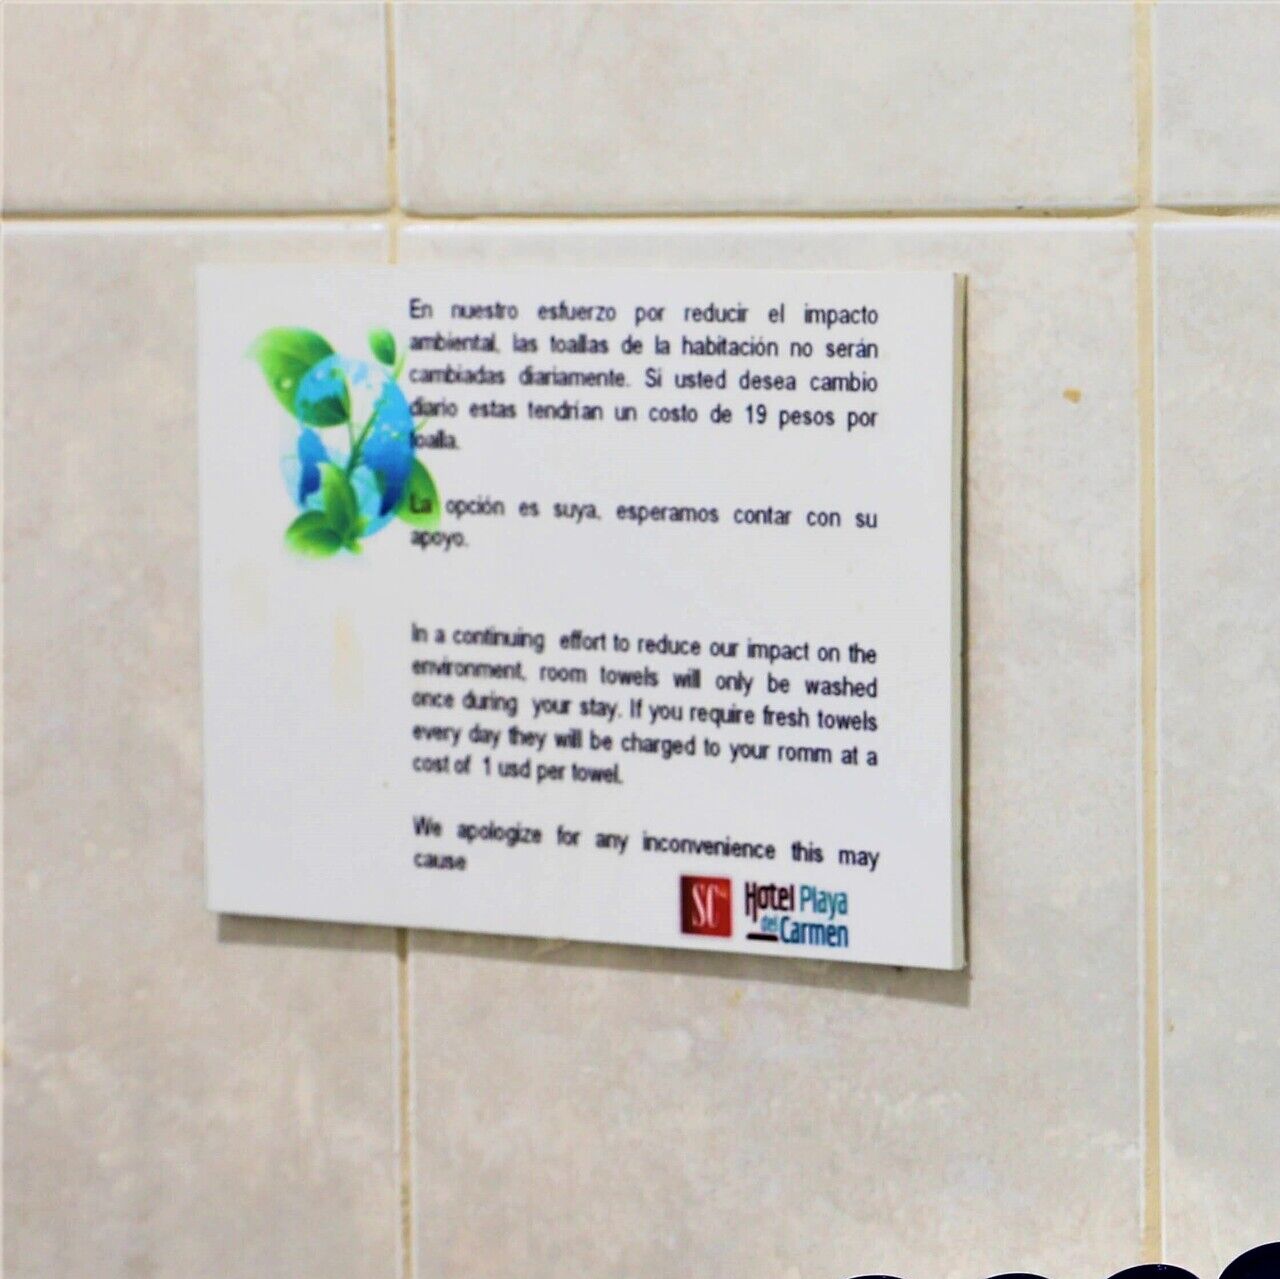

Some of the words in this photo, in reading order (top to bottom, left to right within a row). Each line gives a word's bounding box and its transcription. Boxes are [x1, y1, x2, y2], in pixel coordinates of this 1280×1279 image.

[409, 298, 433, 319] En
[451, 302, 518, 319] nuestro
[538, 301, 616, 321] esfuerzo
[635, 307, 664, 326] por
[685, 303, 748, 323] reducir
[768, 303, 784, 323] el
[804, 306, 878, 329] impacto
[513, 334, 538, 353] las
[550, 334, 609, 354] toallas
[621, 335, 643, 355] de
[655, 335, 670, 355] la
[682, 336, 778, 356] habitación
[790, 342, 813, 357] no
[826, 339, 878, 358] serán
[409, 364, 505, 385] cambiadas
[519, 365, 631, 387] diariamente.
[645, 367, 662, 388] Si
[675, 369, 727, 389] usted
[739, 370, 796, 391] desea
[810, 371, 878, 392] cambio
[410, 397, 458, 417] diario
[469, 400, 517, 418] estas
[615, 406, 637, 421] un
[649, 404, 698, 423] costo
[710, 404, 732, 424] de
[746, 404, 767, 424] 19
[779, 410, 835, 430] pesos
[847, 411, 878, 432] por
[410, 493, 432, 514] La
[446, 499, 505, 519] opción
[519, 502, 540, 517] es
[616, 505, 719, 525] esperamos
[734, 506, 792, 525] contar
[807, 511, 841, 527] con
[855, 513, 877, 528] su
[411, 530, 468, 551] apoyo.
[412, 623, 428, 642] In
[435, 629, 446, 644] a
[453, 627, 545, 654] continuing
[559, 630, 606, 651] effort
[613, 634, 630, 652] to
[638, 634, 701, 656] reduce
[709, 642, 739, 657] our
[747, 639, 809, 664] impact
[817, 647, 840, 662] on
[848, 643, 877, 664] the
[540, 666, 587, 683] room
[600, 666, 659, 687] towels
[673, 668, 701, 689] will
[715, 671, 754, 697] only
[767, 672, 790, 694] be
[805, 676, 877, 698] washed
[412, 691, 454, 709] once
[462, 690, 518, 718] during
[532, 699, 571, 718] your
[580, 698, 623, 723] stay.
[630, 698, 642, 718] If
[649, 705, 683, 724] you
[690, 704, 755, 728] require
[763, 705, 809, 728] fresh
[817, 710, 878, 732] towels
[412, 725, 461, 746] every
[469, 723, 501, 749] day
[508, 725, 547, 752] they
[554, 728, 583, 749] will
[590, 730, 613, 751] be
[621, 732, 696, 760] charged
[704, 738, 720, 757] to
[730, 743, 770, 763] your
[778, 746, 832, 763] romm
[841, 746, 858, 765] at
[866, 751, 878, 766] a
[413, 756, 449, 773] cost
[454, 755, 471, 774] of
[483, 756, 491, 775] 1
[498, 759, 531, 779] usd
[537, 764, 565, 784] per
[571, 763, 623, 784] towel.
[413, 816, 442, 837] We
[457, 821, 542, 848] apologize
[557, 825, 581, 846] for
[595, 833, 628, 855] any
[643, 831, 776, 860] inconvenience
[791, 841, 824, 863] this
[838, 849, 880, 871] may
[414, 853, 467, 871] cause
[745, 882, 795, 922] Hotel
[799, 884, 848, 920] Playa
[780, 915, 849, 948] Carmen
